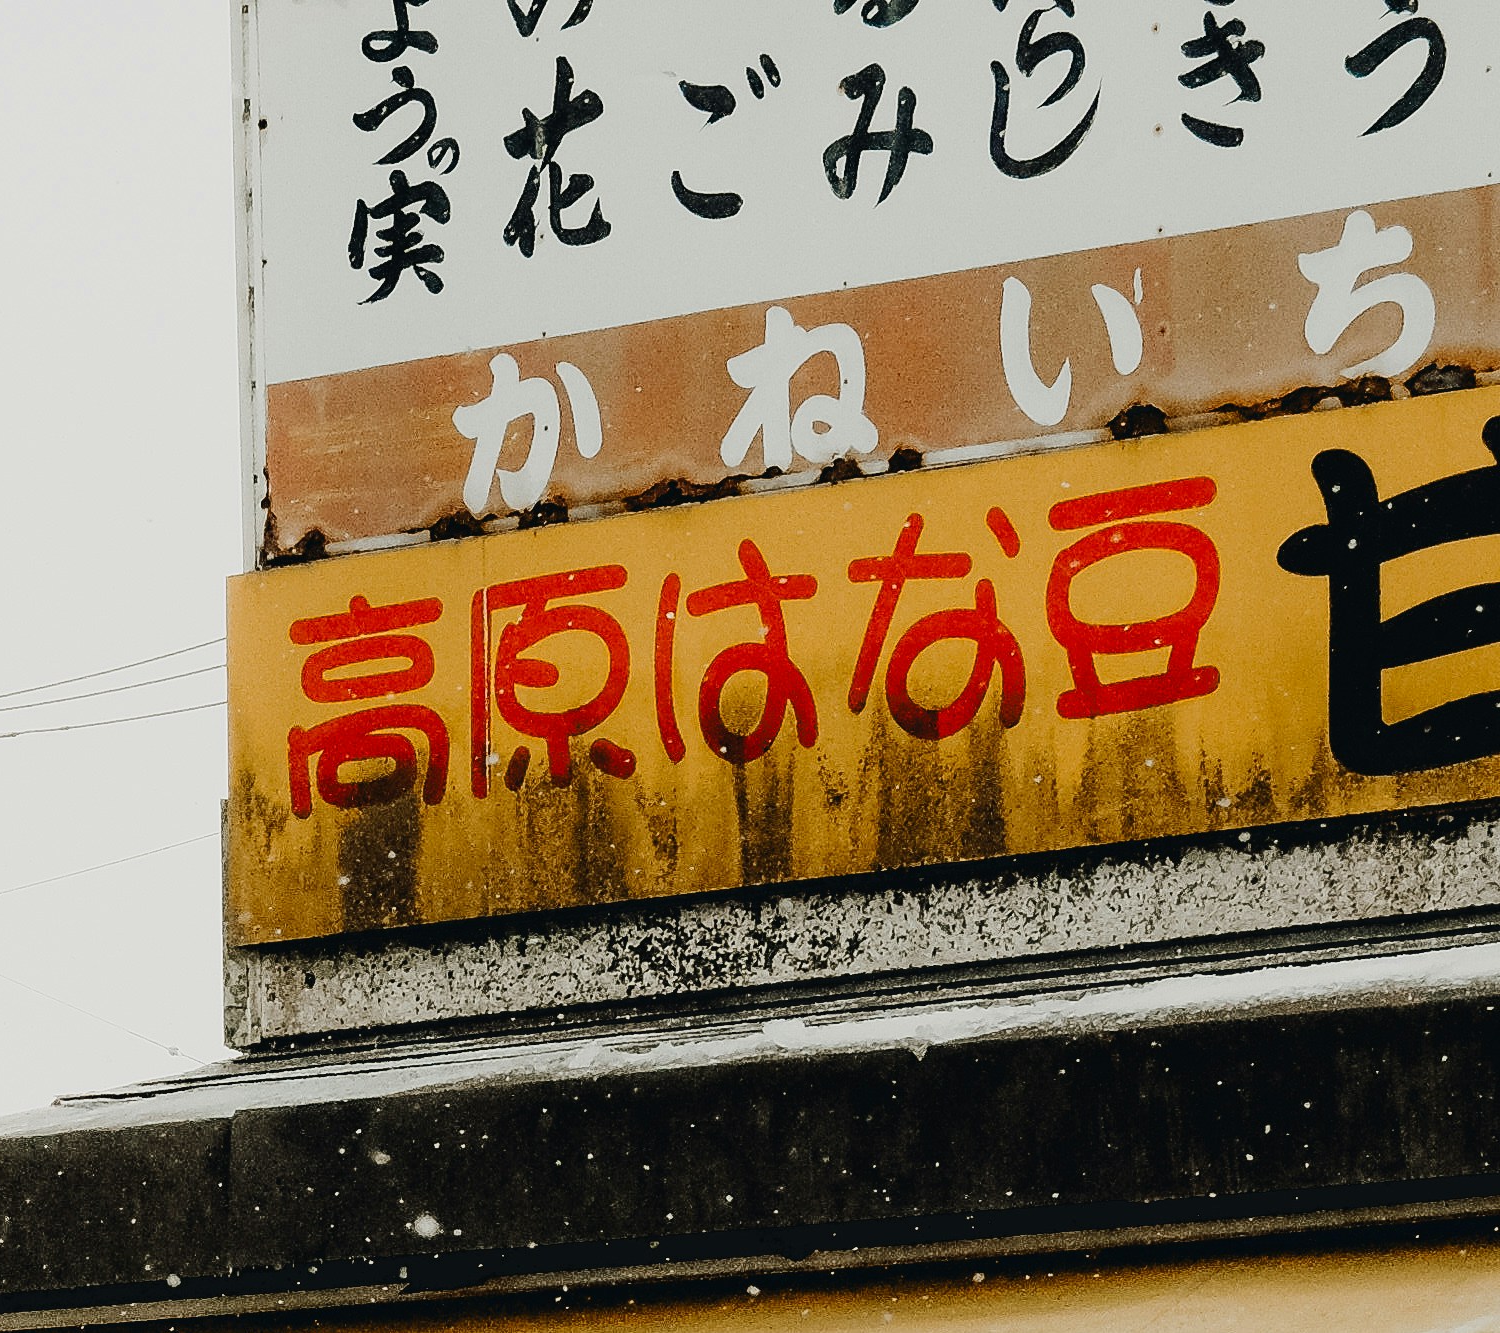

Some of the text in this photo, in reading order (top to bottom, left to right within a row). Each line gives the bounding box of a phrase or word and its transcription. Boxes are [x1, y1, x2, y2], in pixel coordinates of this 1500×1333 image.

[453, 210, 1436, 511] かねいち
[287, 476, 1222, 817] 高原はな豆
